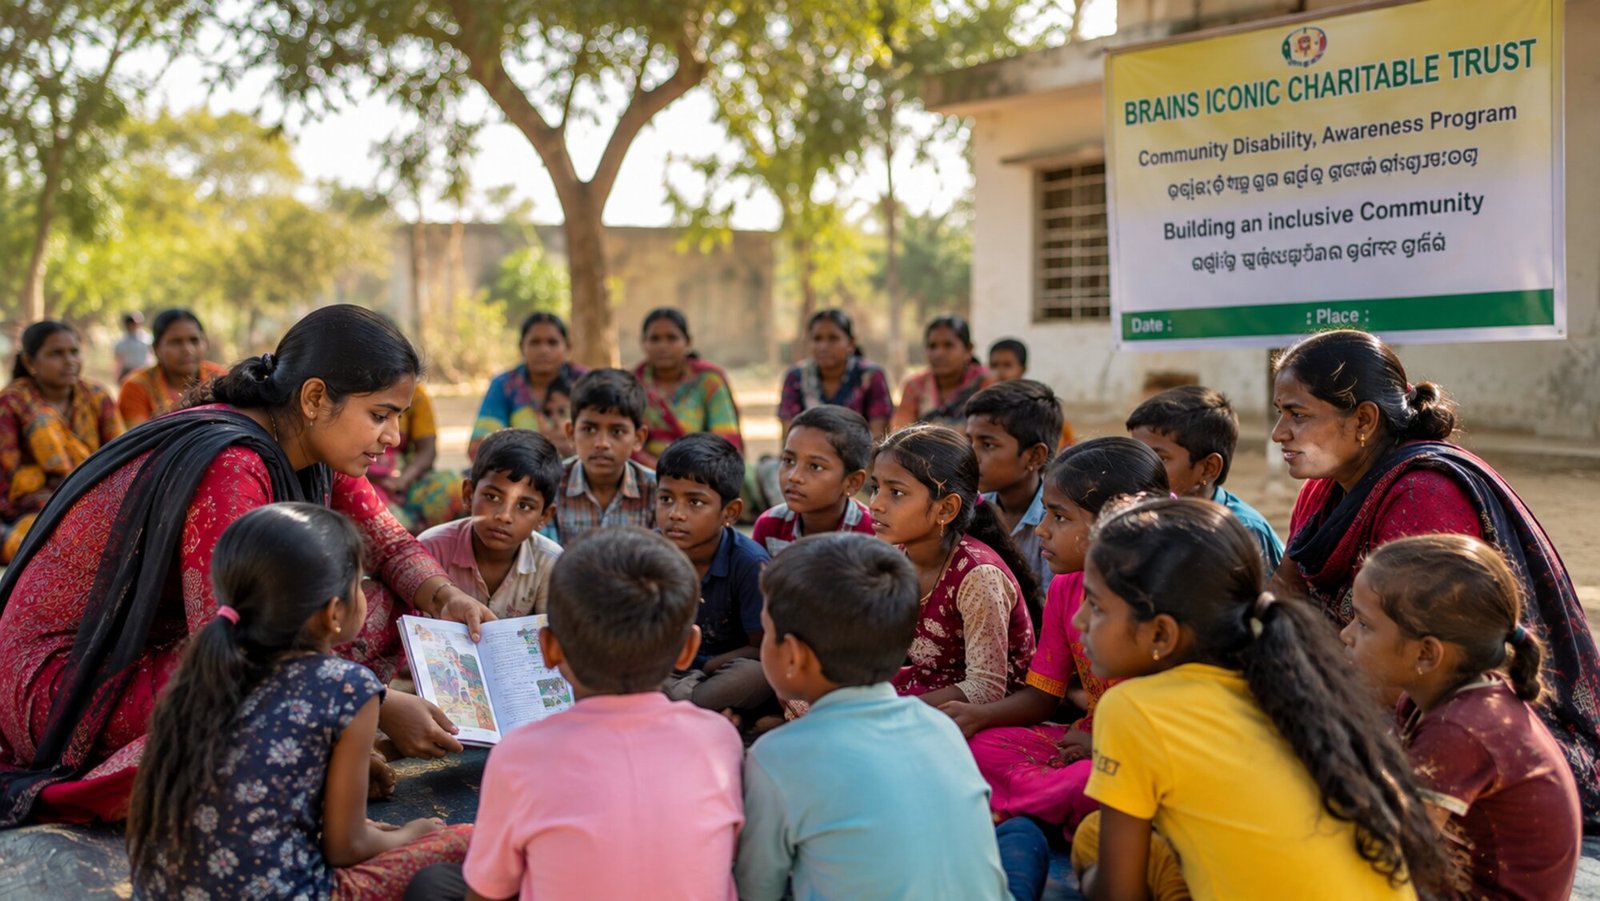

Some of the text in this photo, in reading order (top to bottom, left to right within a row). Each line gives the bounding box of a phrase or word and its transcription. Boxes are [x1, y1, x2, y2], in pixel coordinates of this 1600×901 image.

[1125, 38, 1538, 125] BRAINS ICONIC CHARITABLE TRUST
[1138, 105, 1517, 167] Community Disability, Awareness Program
[1164, 192, 1485, 240] Building an inclusive Community
[1131, 318, 1163, 333] Date
[1316, 308, 1360, 324] Place
